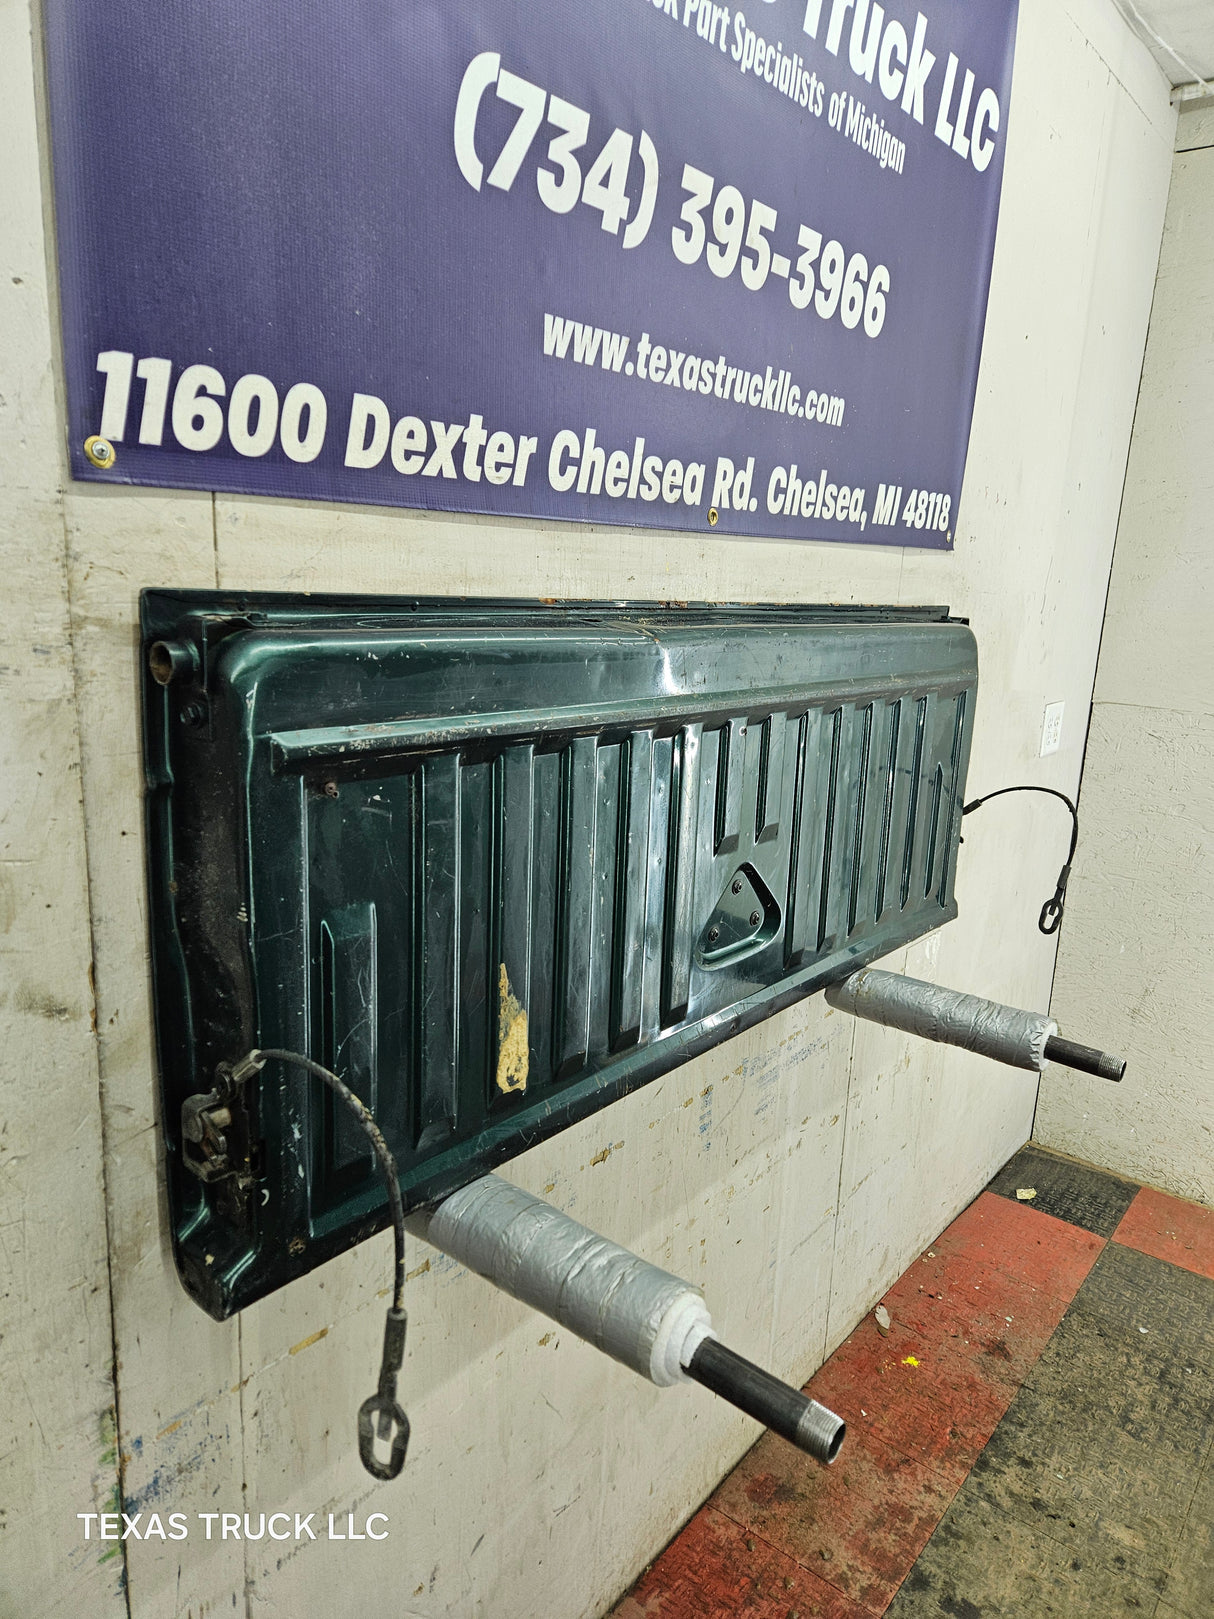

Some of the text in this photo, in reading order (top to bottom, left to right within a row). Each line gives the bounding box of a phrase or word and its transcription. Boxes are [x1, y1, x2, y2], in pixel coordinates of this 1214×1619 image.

[683, 0, 906, 175] Part Specialists of Michigan
[934, 51, 1000, 172] LLC
[453, 51, 891, 339] (734) 395-3966
[96, 350, 952, 532] 11600 Dexter Chelsea Rd. Chelsea, MI 48118
[543, 312, 846, 427] www.texastruckllc.com
